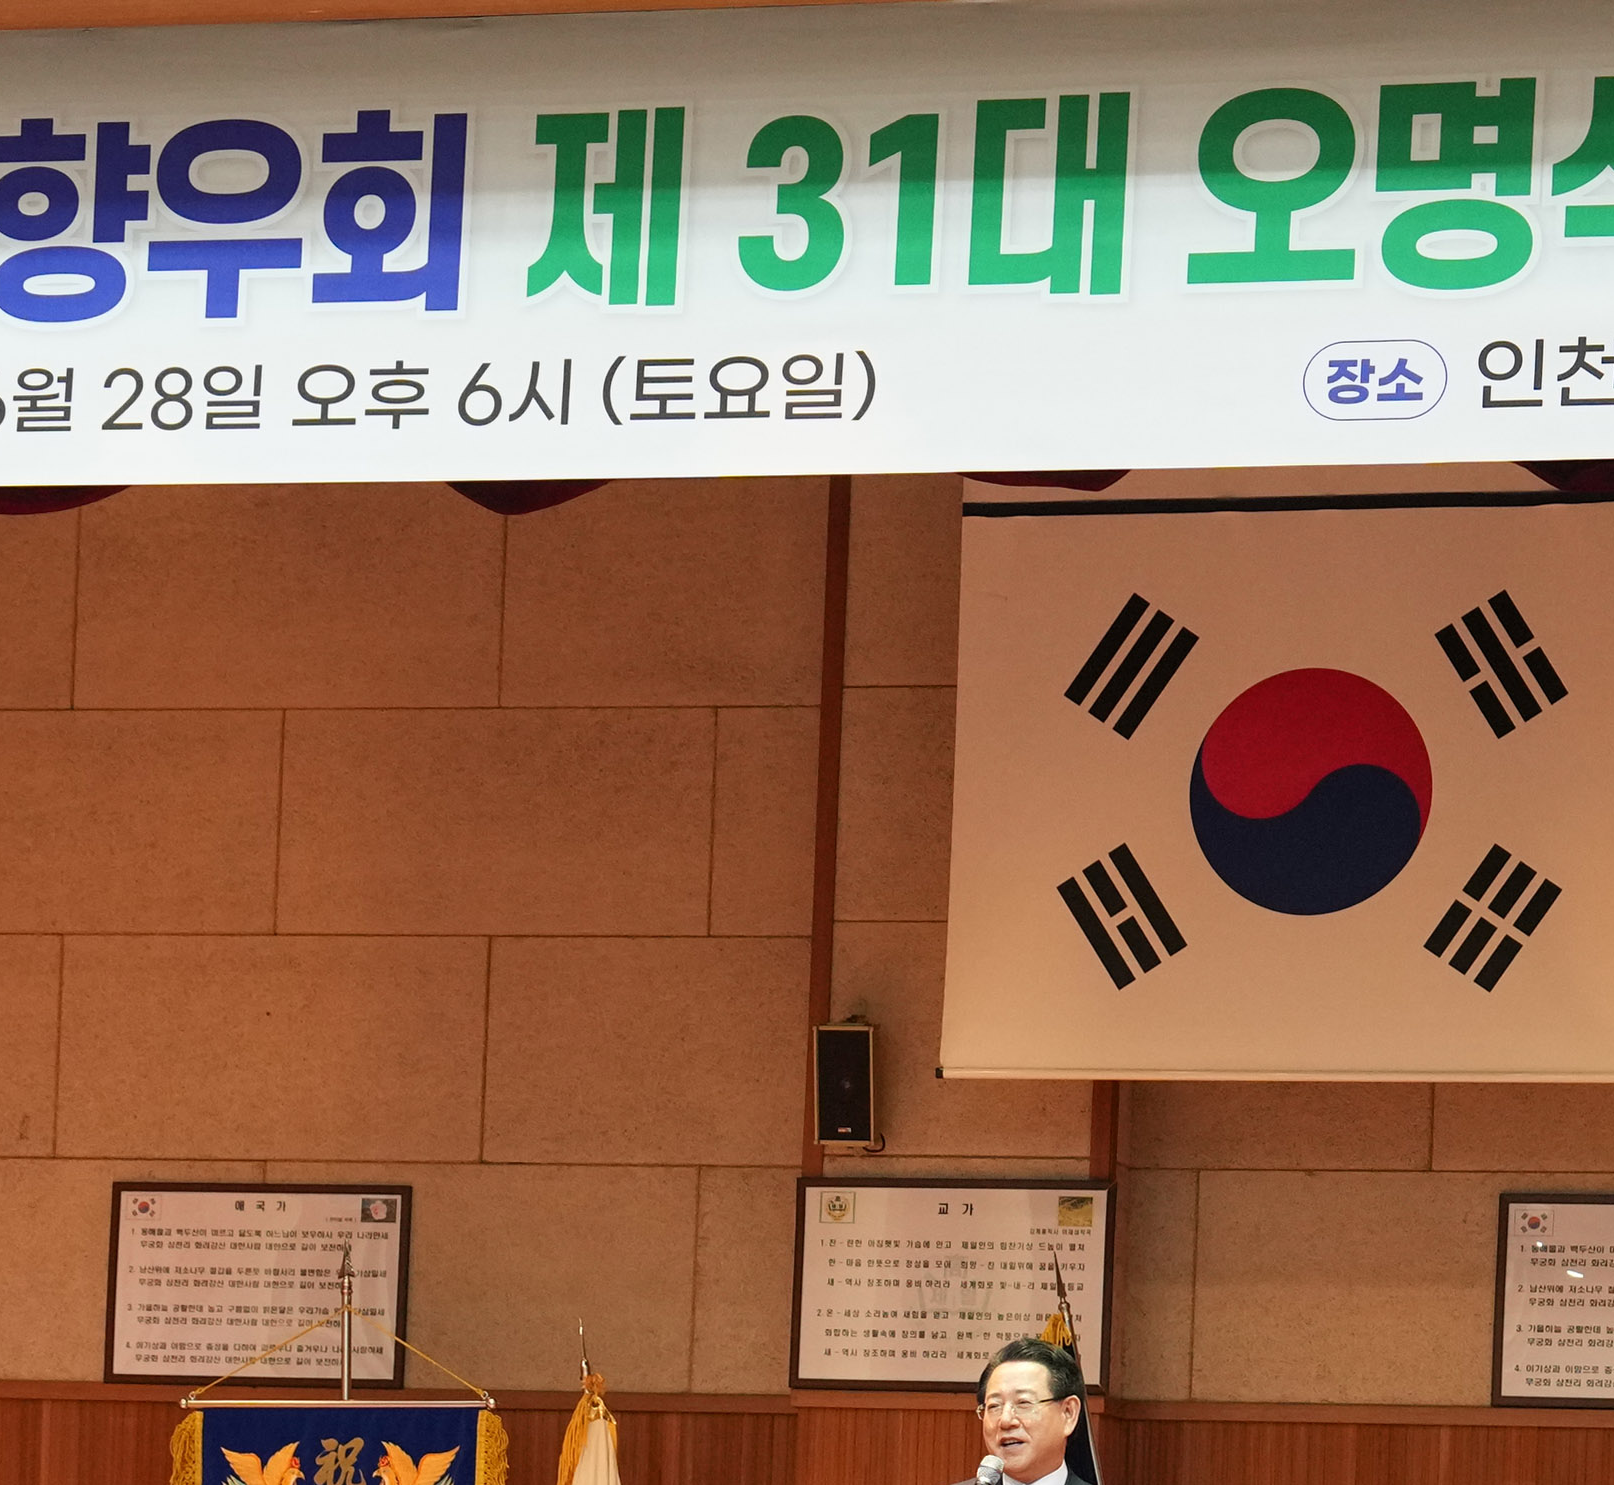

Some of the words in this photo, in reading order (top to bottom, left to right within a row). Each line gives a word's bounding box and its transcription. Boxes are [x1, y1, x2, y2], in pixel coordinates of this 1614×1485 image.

[527, 106, 685, 307] 제
[737, 91, 1131, 296] 31대
[101, 365, 264, 433] 28일
[291, 360, 432, 430] 오후
[456, 359, 573, 429] 6시
[603, 349, 877, 427] (토요일)
[1325, 359, 1425, 404] 장소
